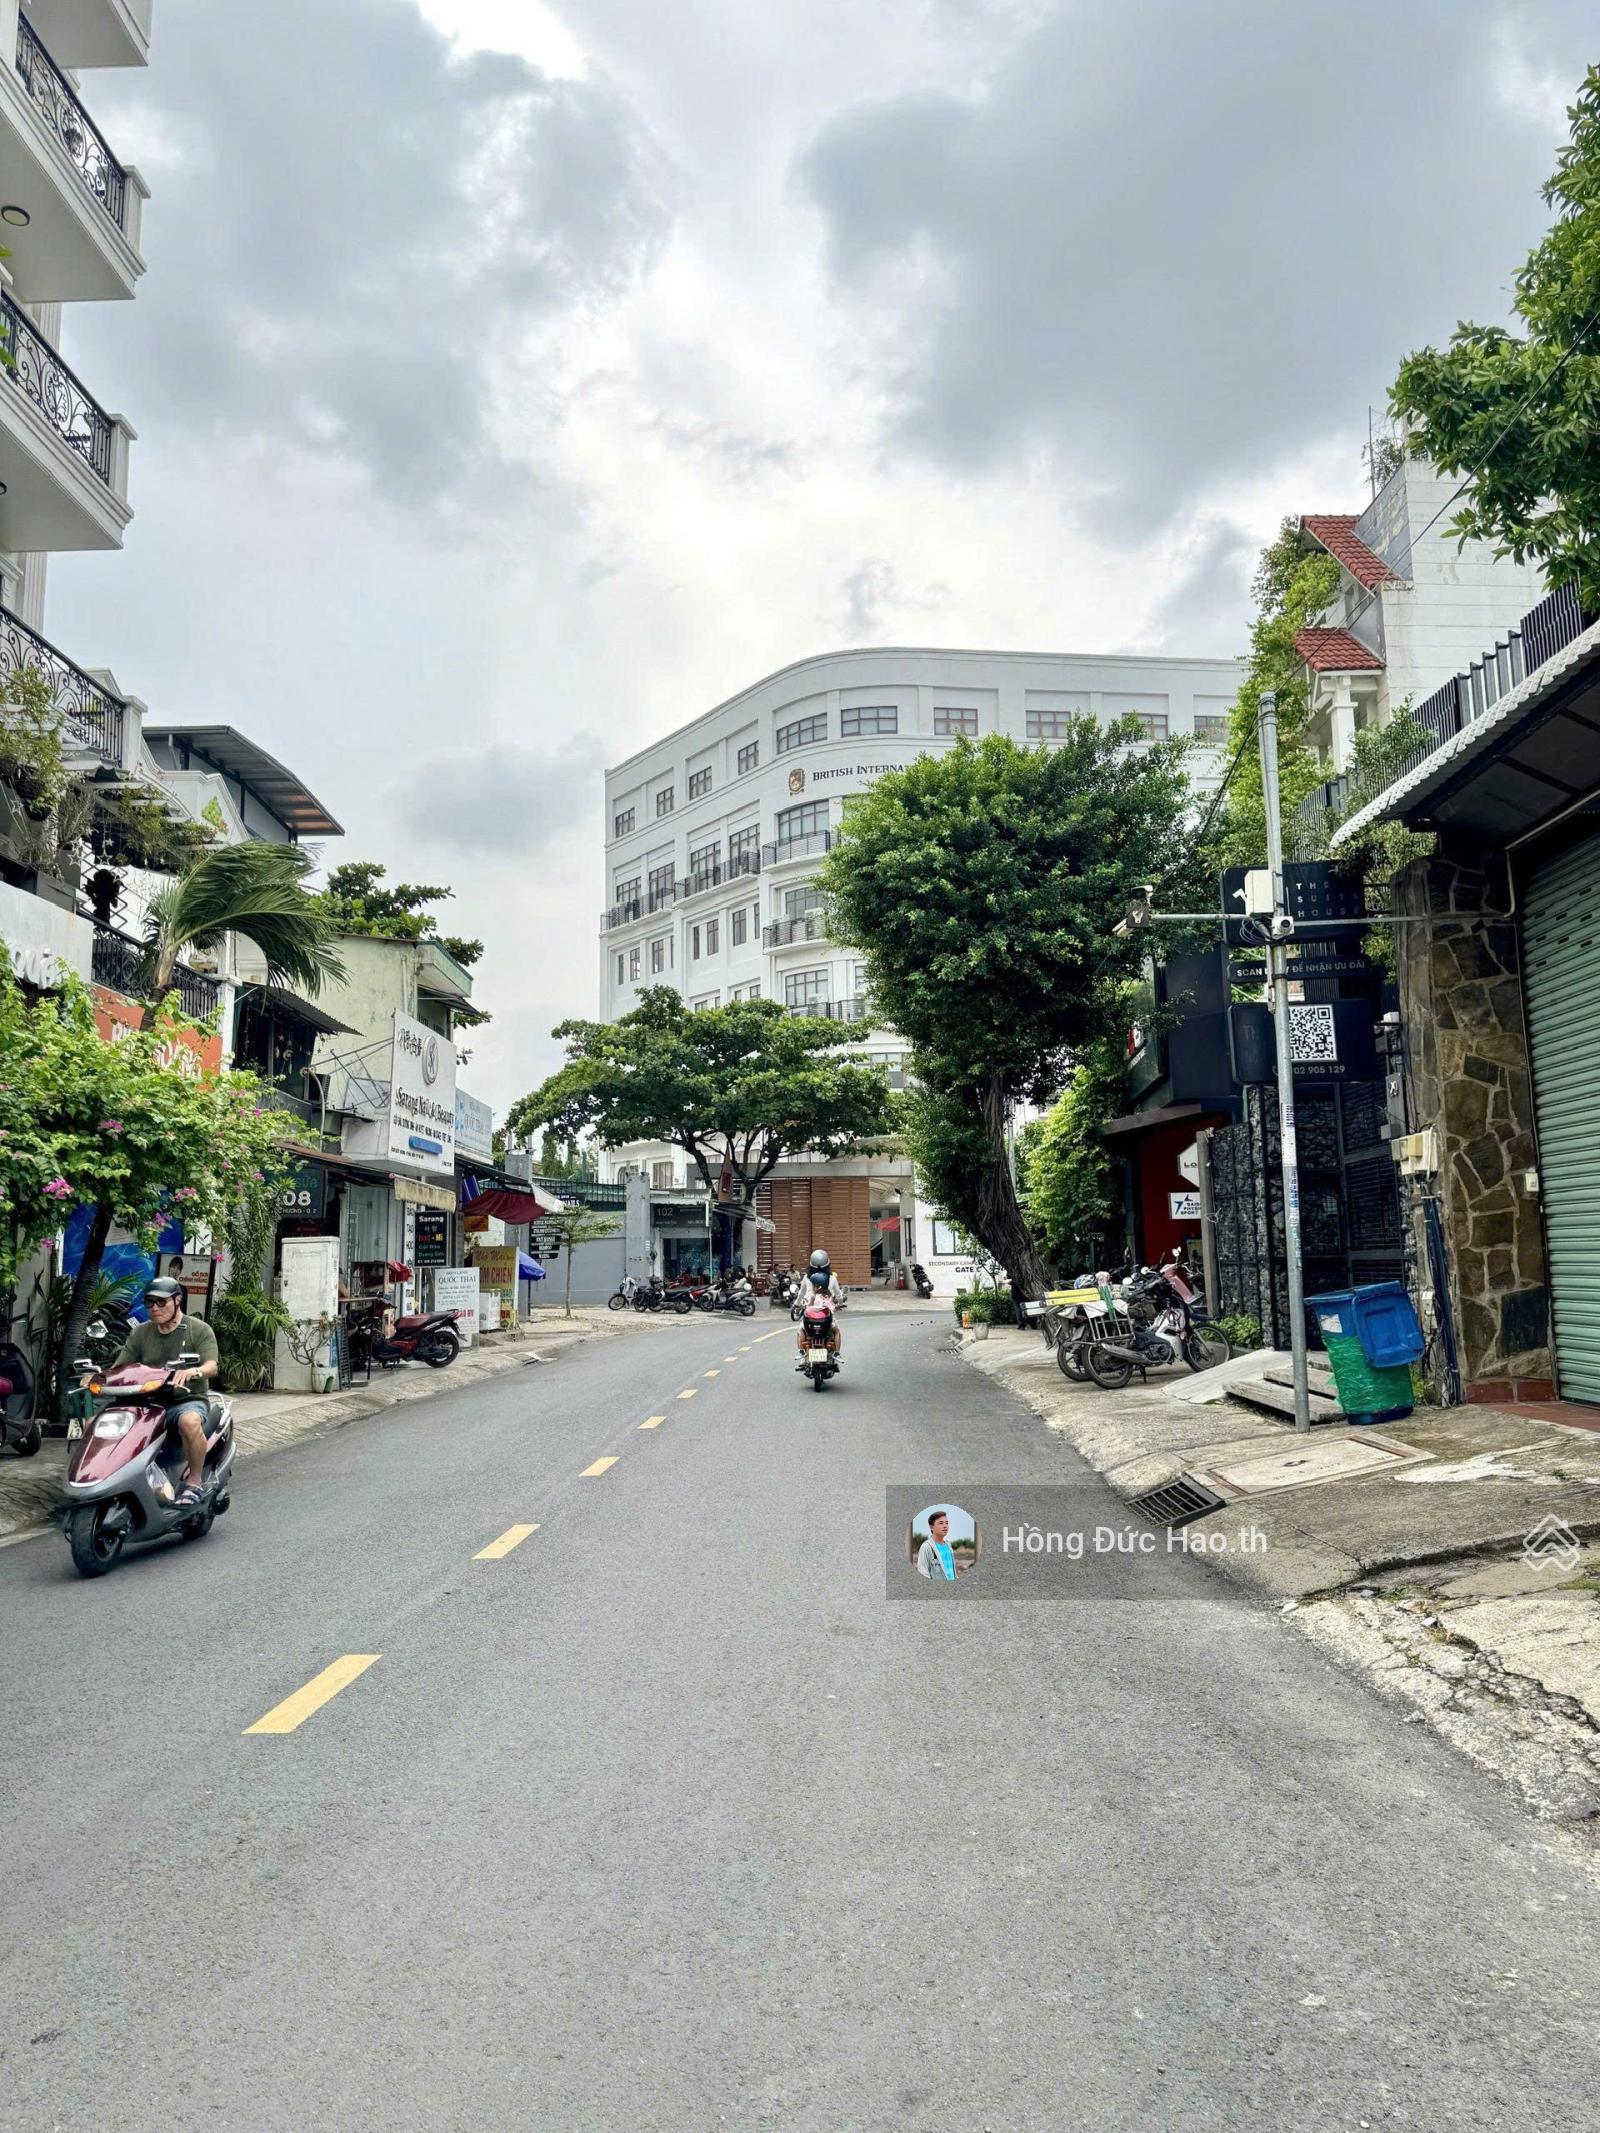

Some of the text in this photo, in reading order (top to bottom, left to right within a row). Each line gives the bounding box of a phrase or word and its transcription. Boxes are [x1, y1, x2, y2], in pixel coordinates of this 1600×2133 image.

[812, 764, 905, 781] BRITISH INTERNA
[1236, 968, 1263, 977] SCAN
[1305, 963, 1333, 973] NHẬN
[1293, 1065, 1346, 1075] 02 905 129
[656, 1207, 674, 1217] 102
[418, 1215, 445, 1223] Sarang
